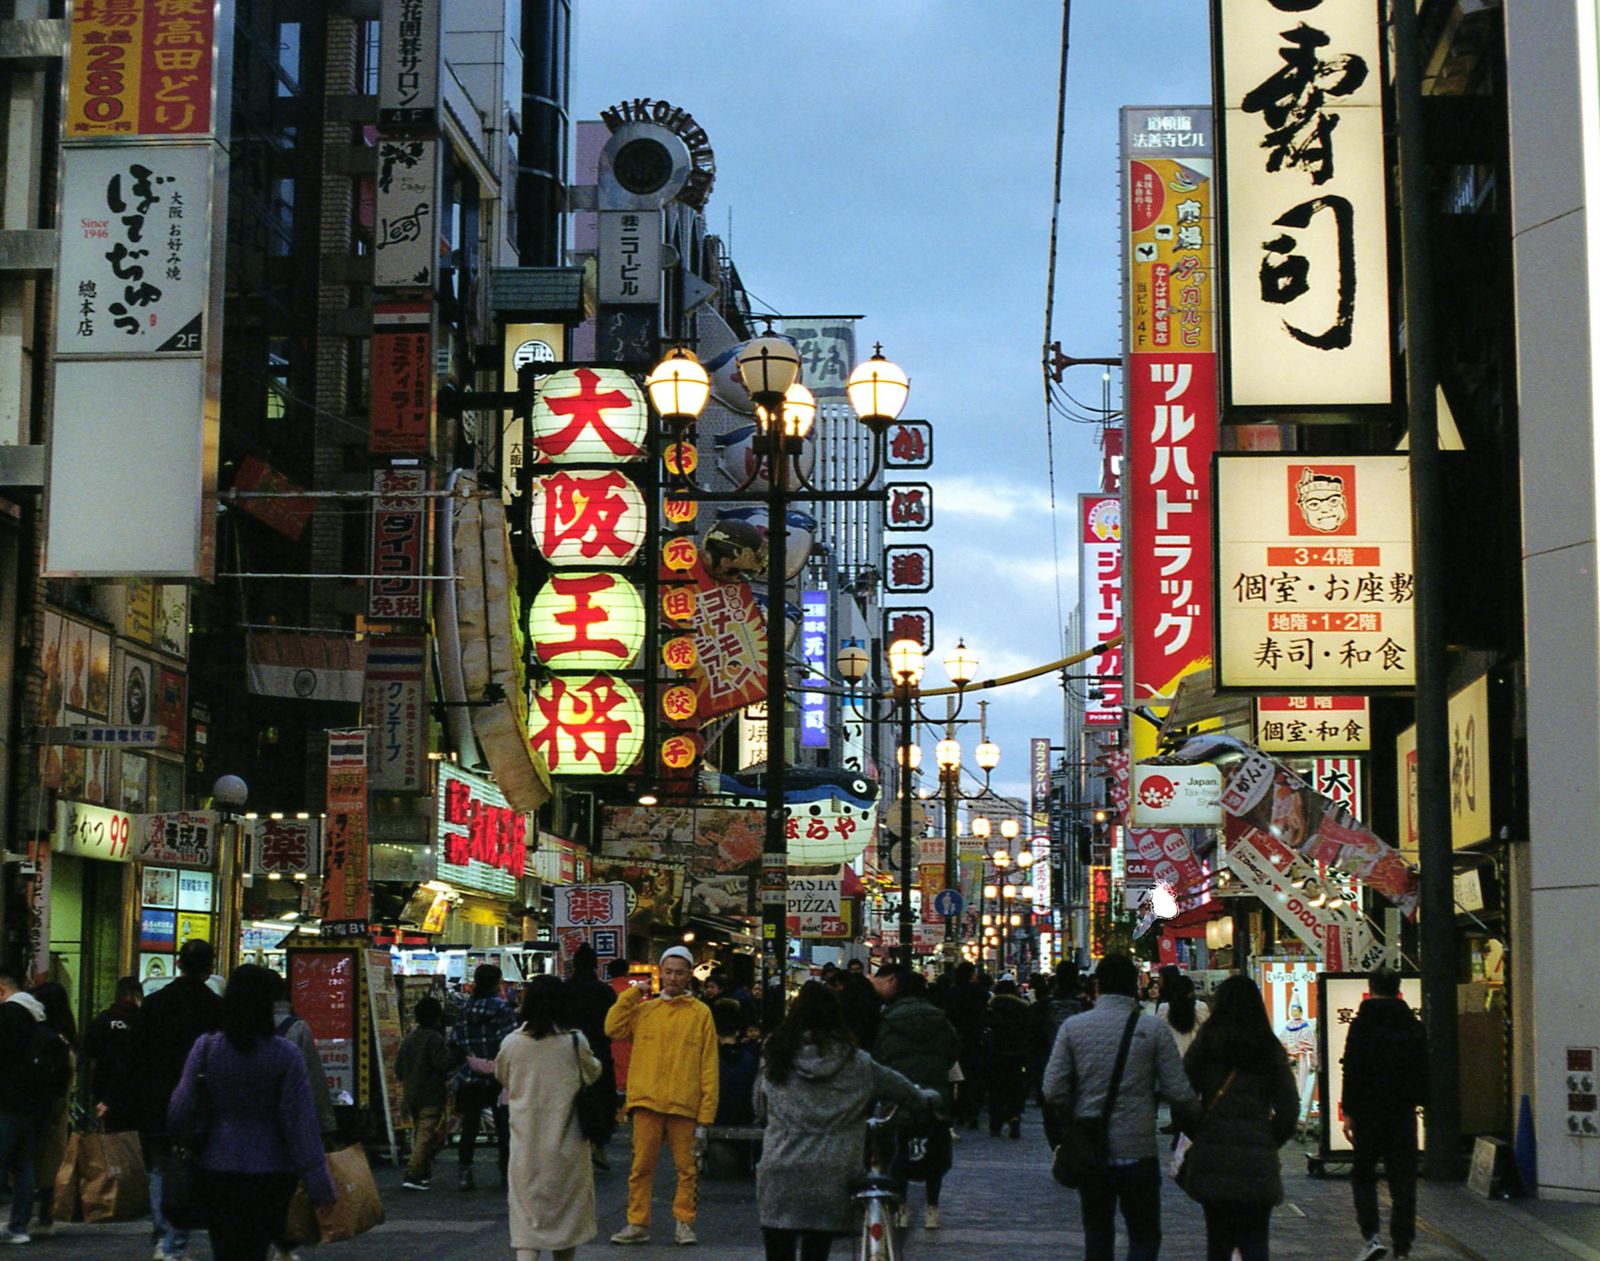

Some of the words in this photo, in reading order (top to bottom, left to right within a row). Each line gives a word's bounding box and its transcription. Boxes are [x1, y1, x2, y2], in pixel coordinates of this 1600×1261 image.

[1132, 132, 1207, 148] 法善寺ビル
[167, 190, 185, 220] 大阪
[80, 217, 110, 230] Since
[82, 229, 110, 241] 1946
[165, 224, 184, 282] お好み焼
[175, 333, 199, 349] 2F
[1149, 362, 1200, 656] ツルハドラッグ
[1294, 547, 1355, 565] 3・4階
[529, 367, 648, 773] 大阪王将
[1232, 571, 1414, 604] 個室・お座敷
[1272, 613, 1377, 631] 地階・1・2階
[1254, 636, 1408, 671] 寿司・和食
[1261, 719, 1364, 743] 個室・和食
[787, 899, 837, 913] PIZZA
[822, 920, 840, 932] 2F
